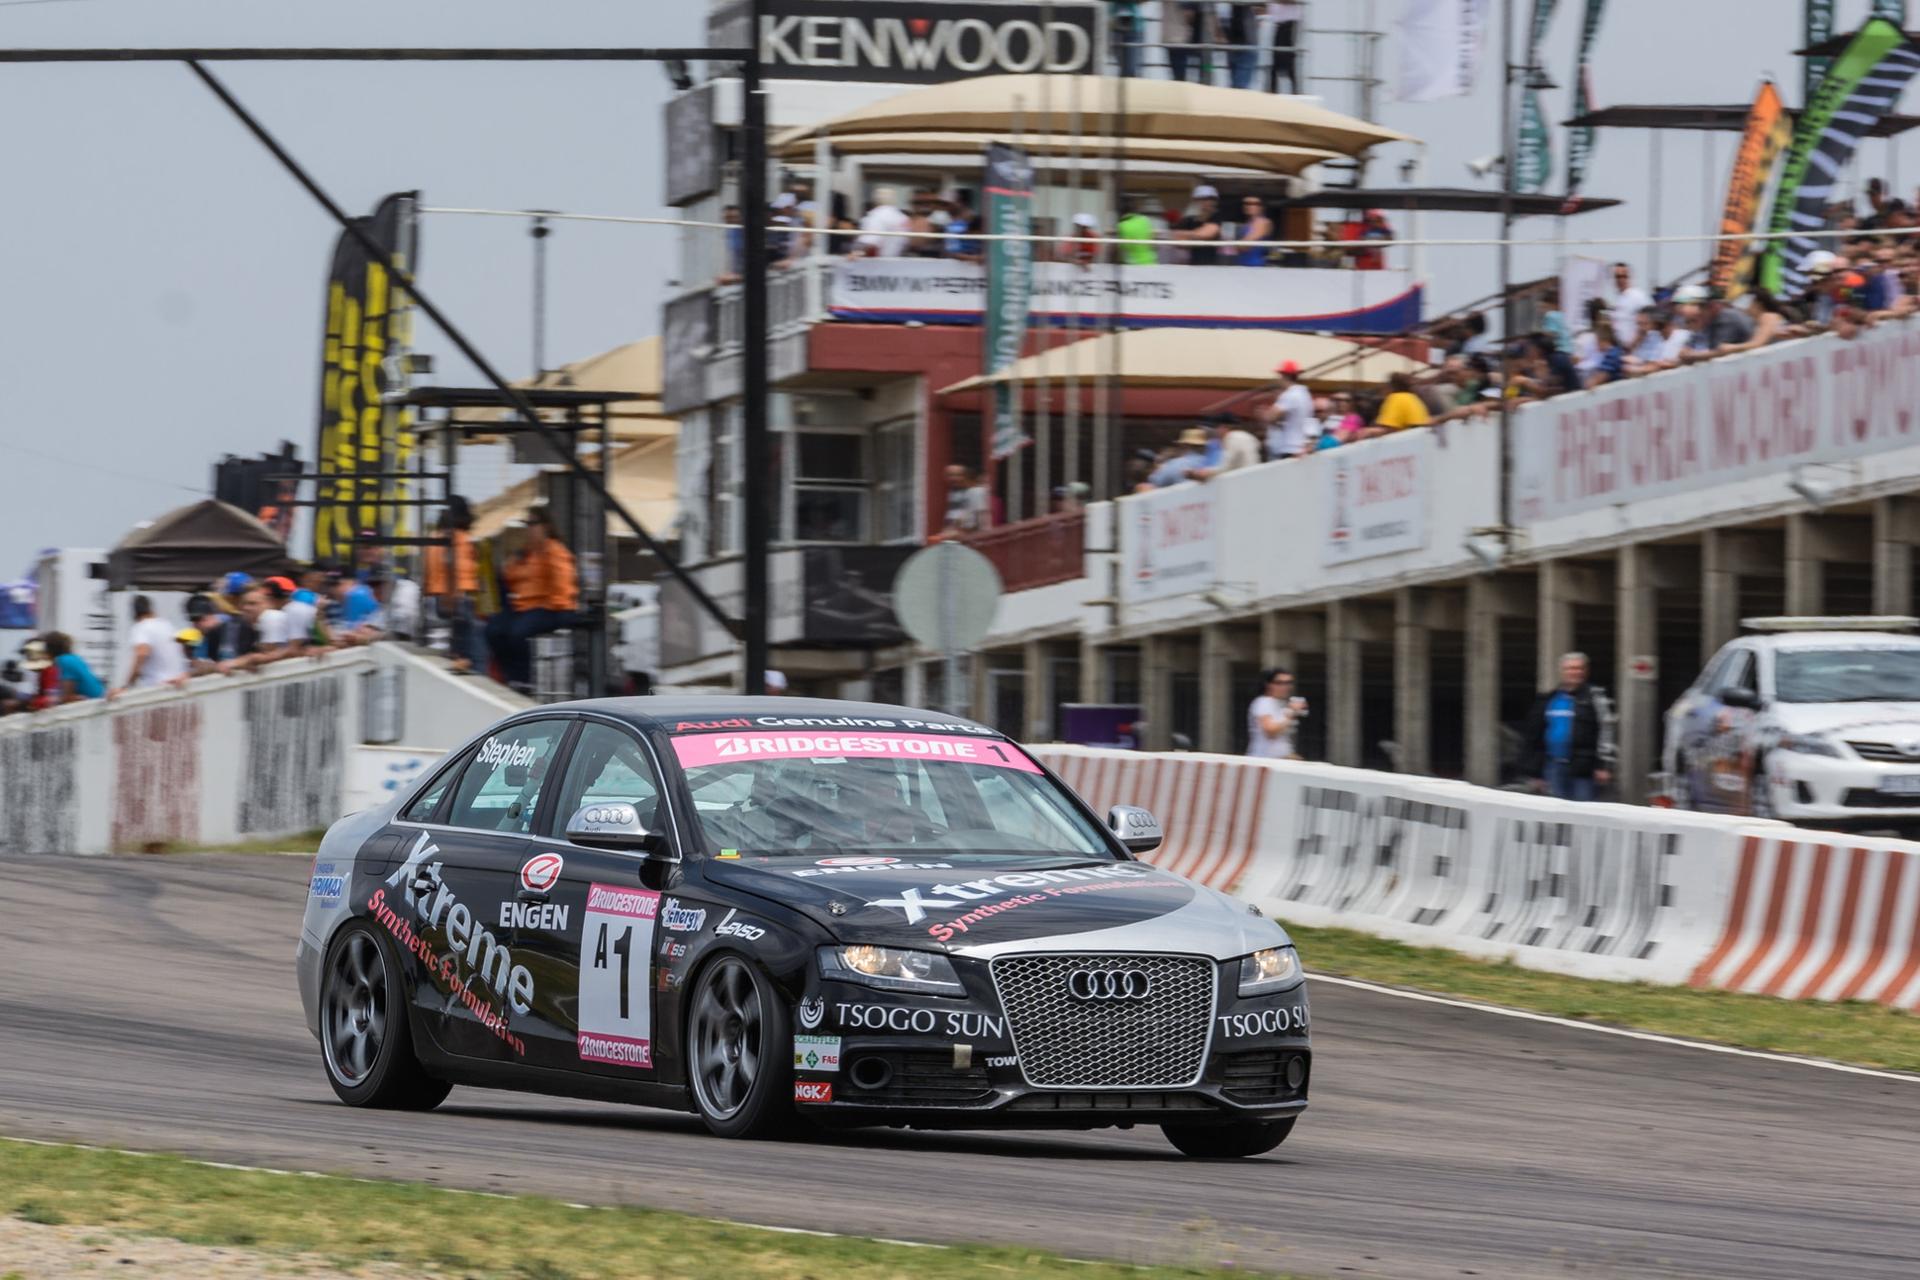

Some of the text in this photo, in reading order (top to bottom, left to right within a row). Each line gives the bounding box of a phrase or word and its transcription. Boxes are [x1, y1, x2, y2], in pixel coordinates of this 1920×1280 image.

[758, 15, 1091, 72] KENWOOD
[1102, 280, 1174, 299] PARTS
[1555, 383, 1699, 499] PRETORIA
[675, 716, 994, 735] Audi Genuine Parts
[476, 736, 536, 771] Stephen
[715, 736, 1011, 763] BRIDGESTONE 1
[792, 863, 952, 877] ENGEN
[588, 887, 659, 916] BRIDGESTONE
[863, 863, 1147, 925] Xtreme
[385, 830, 535, 1016] Xtreme
[500, 902, 570, 931] ENGEN
[928, 891, 1047, 942] Synthetic
[367, 889, 525, 1056] Synthetic Formulation
[836, 1002, 1004, 1039] TSOGO SUN
[1217, 1008, 1290, 1038] TSOGO
[581, 1035, 650, 1063] BRIDGESTONE
[822, 1055, 838, 1065] FAG
[985, 1055, 1018, 1068] TOW
[795, 1085, 822, 1099] NGK
